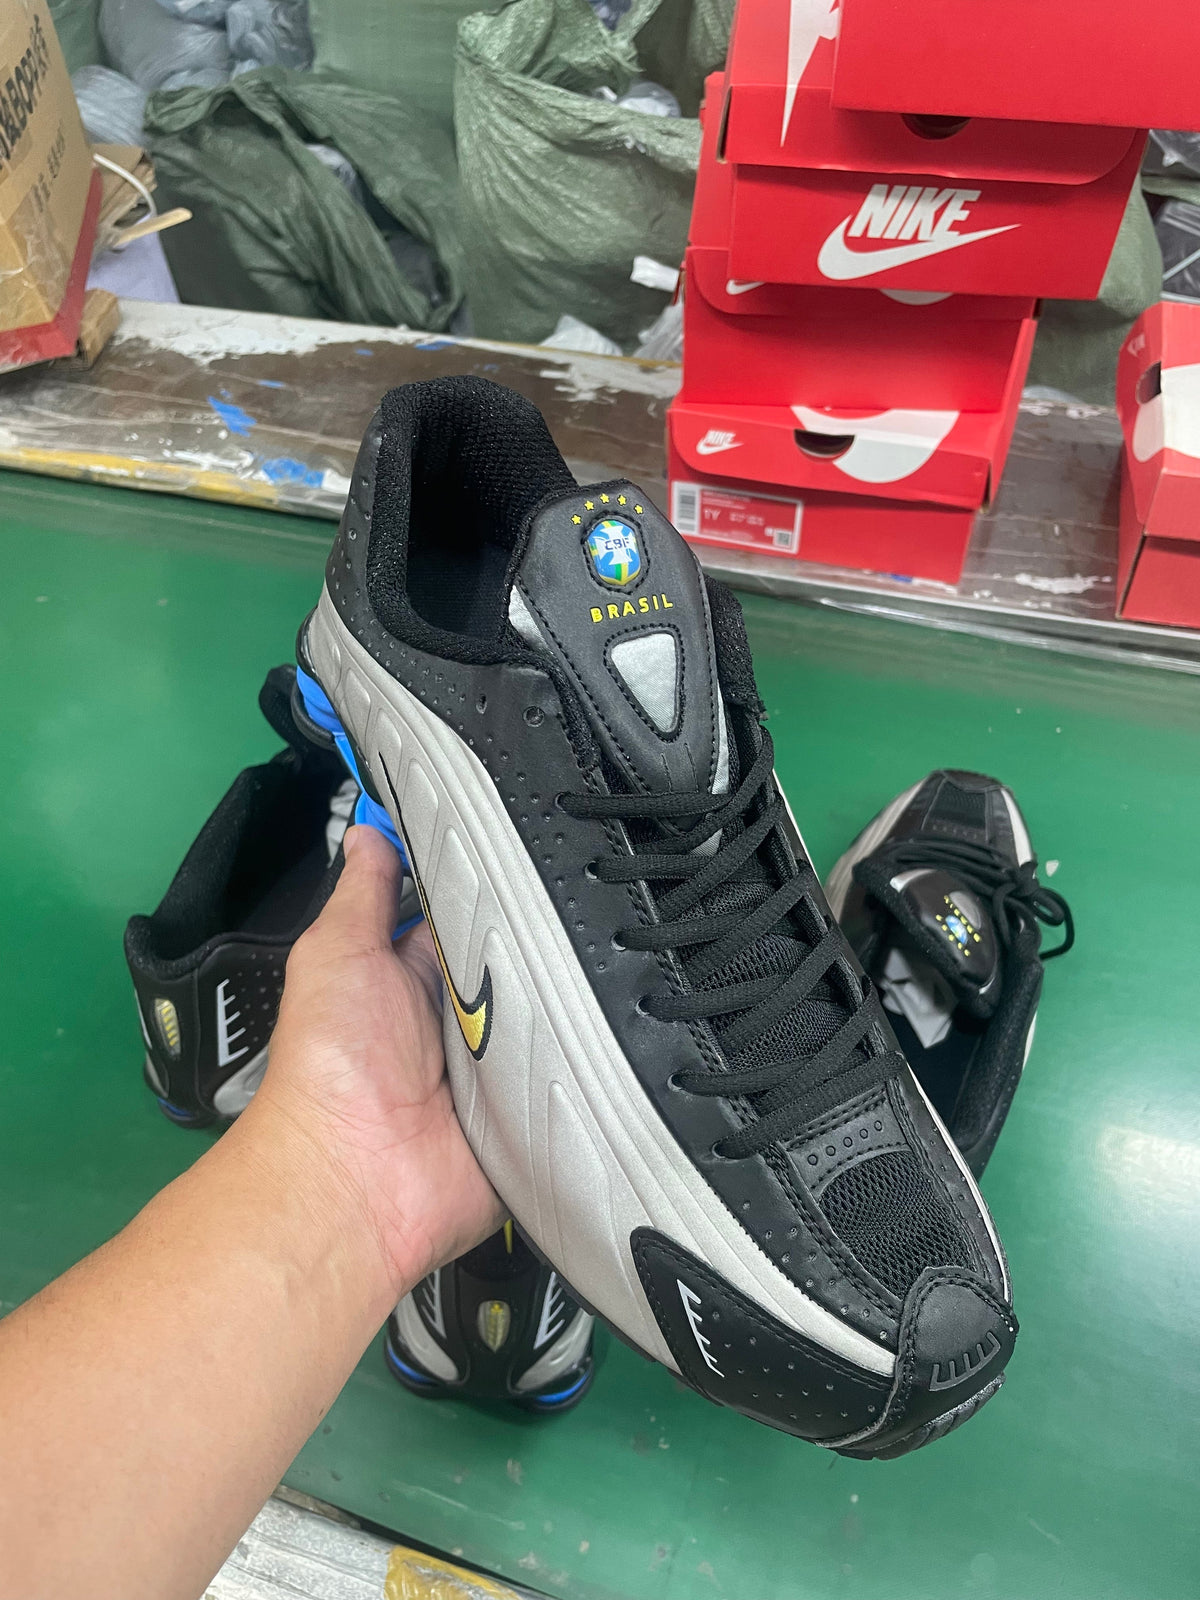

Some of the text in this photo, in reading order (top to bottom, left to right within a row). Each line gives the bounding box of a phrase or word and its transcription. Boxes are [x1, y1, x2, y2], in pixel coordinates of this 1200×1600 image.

[847, 184, 982, 241] NIKE
[704, 429, 736, 446] NIKE
[590, 594, 674, 623] BRASIL
